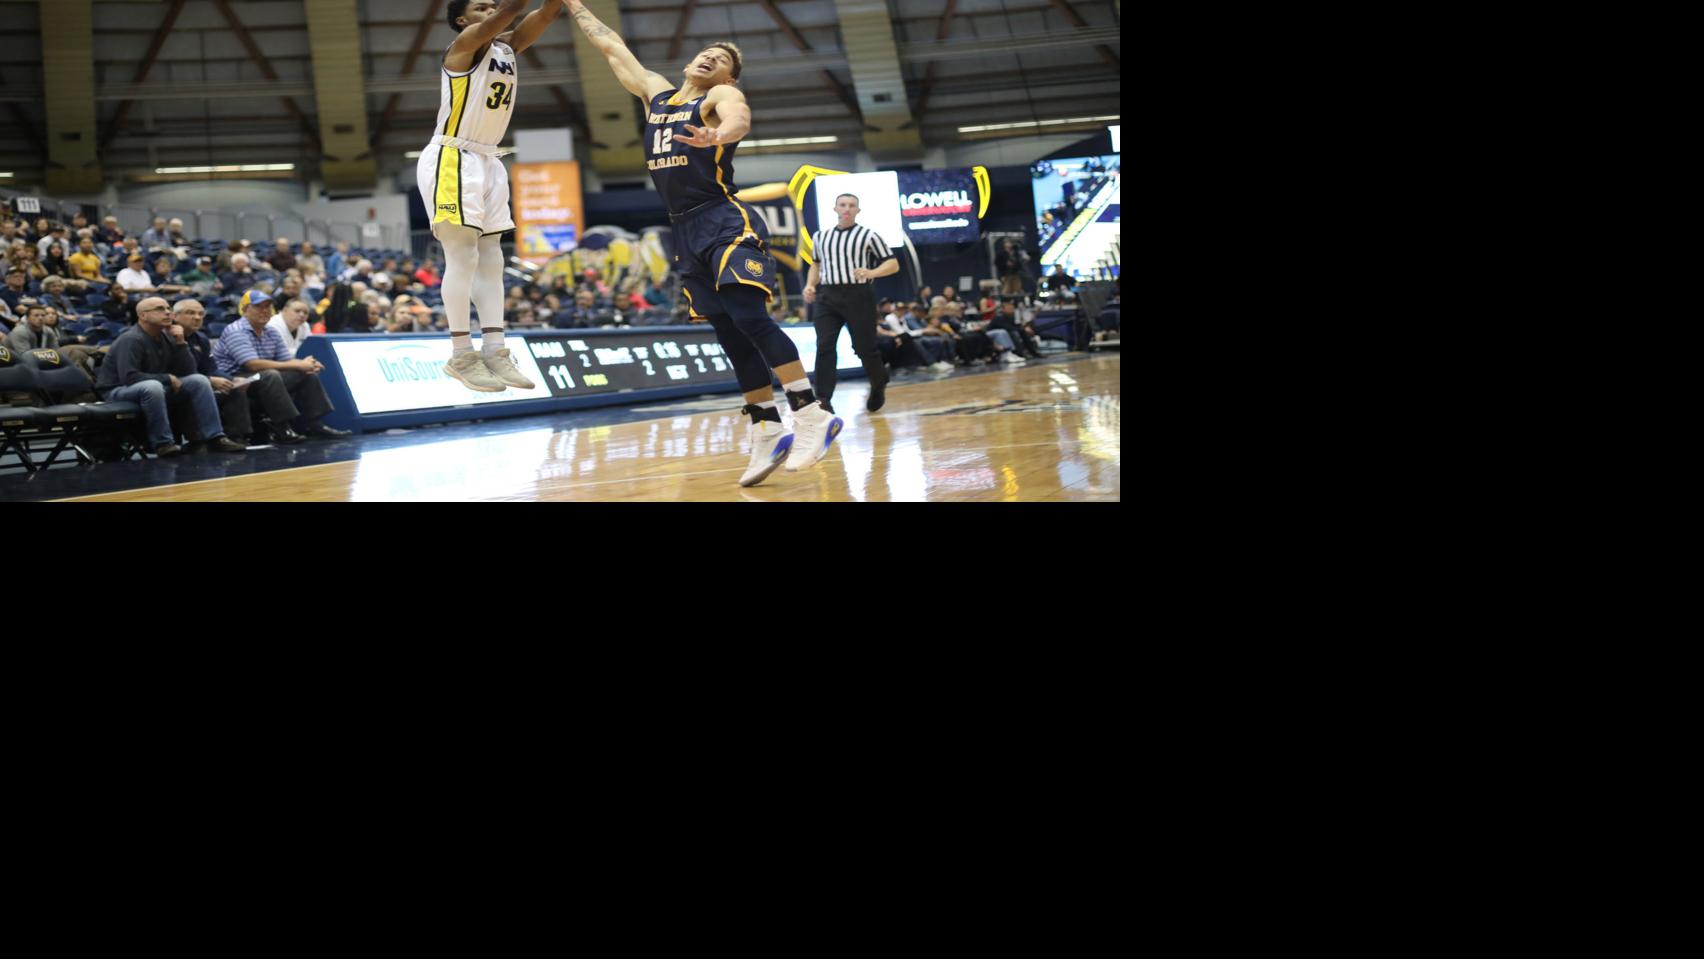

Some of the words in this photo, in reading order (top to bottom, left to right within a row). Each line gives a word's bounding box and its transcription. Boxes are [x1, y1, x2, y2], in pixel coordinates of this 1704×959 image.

[486, 81, 514, 111] 34
[652, 128, 673, 154] 12
[900, 190, 972, 209] LOWELL
[642, 360, 656, 375] 2
[694, 358, 707, 372] 2
[548, 364, 576, 389] 11
